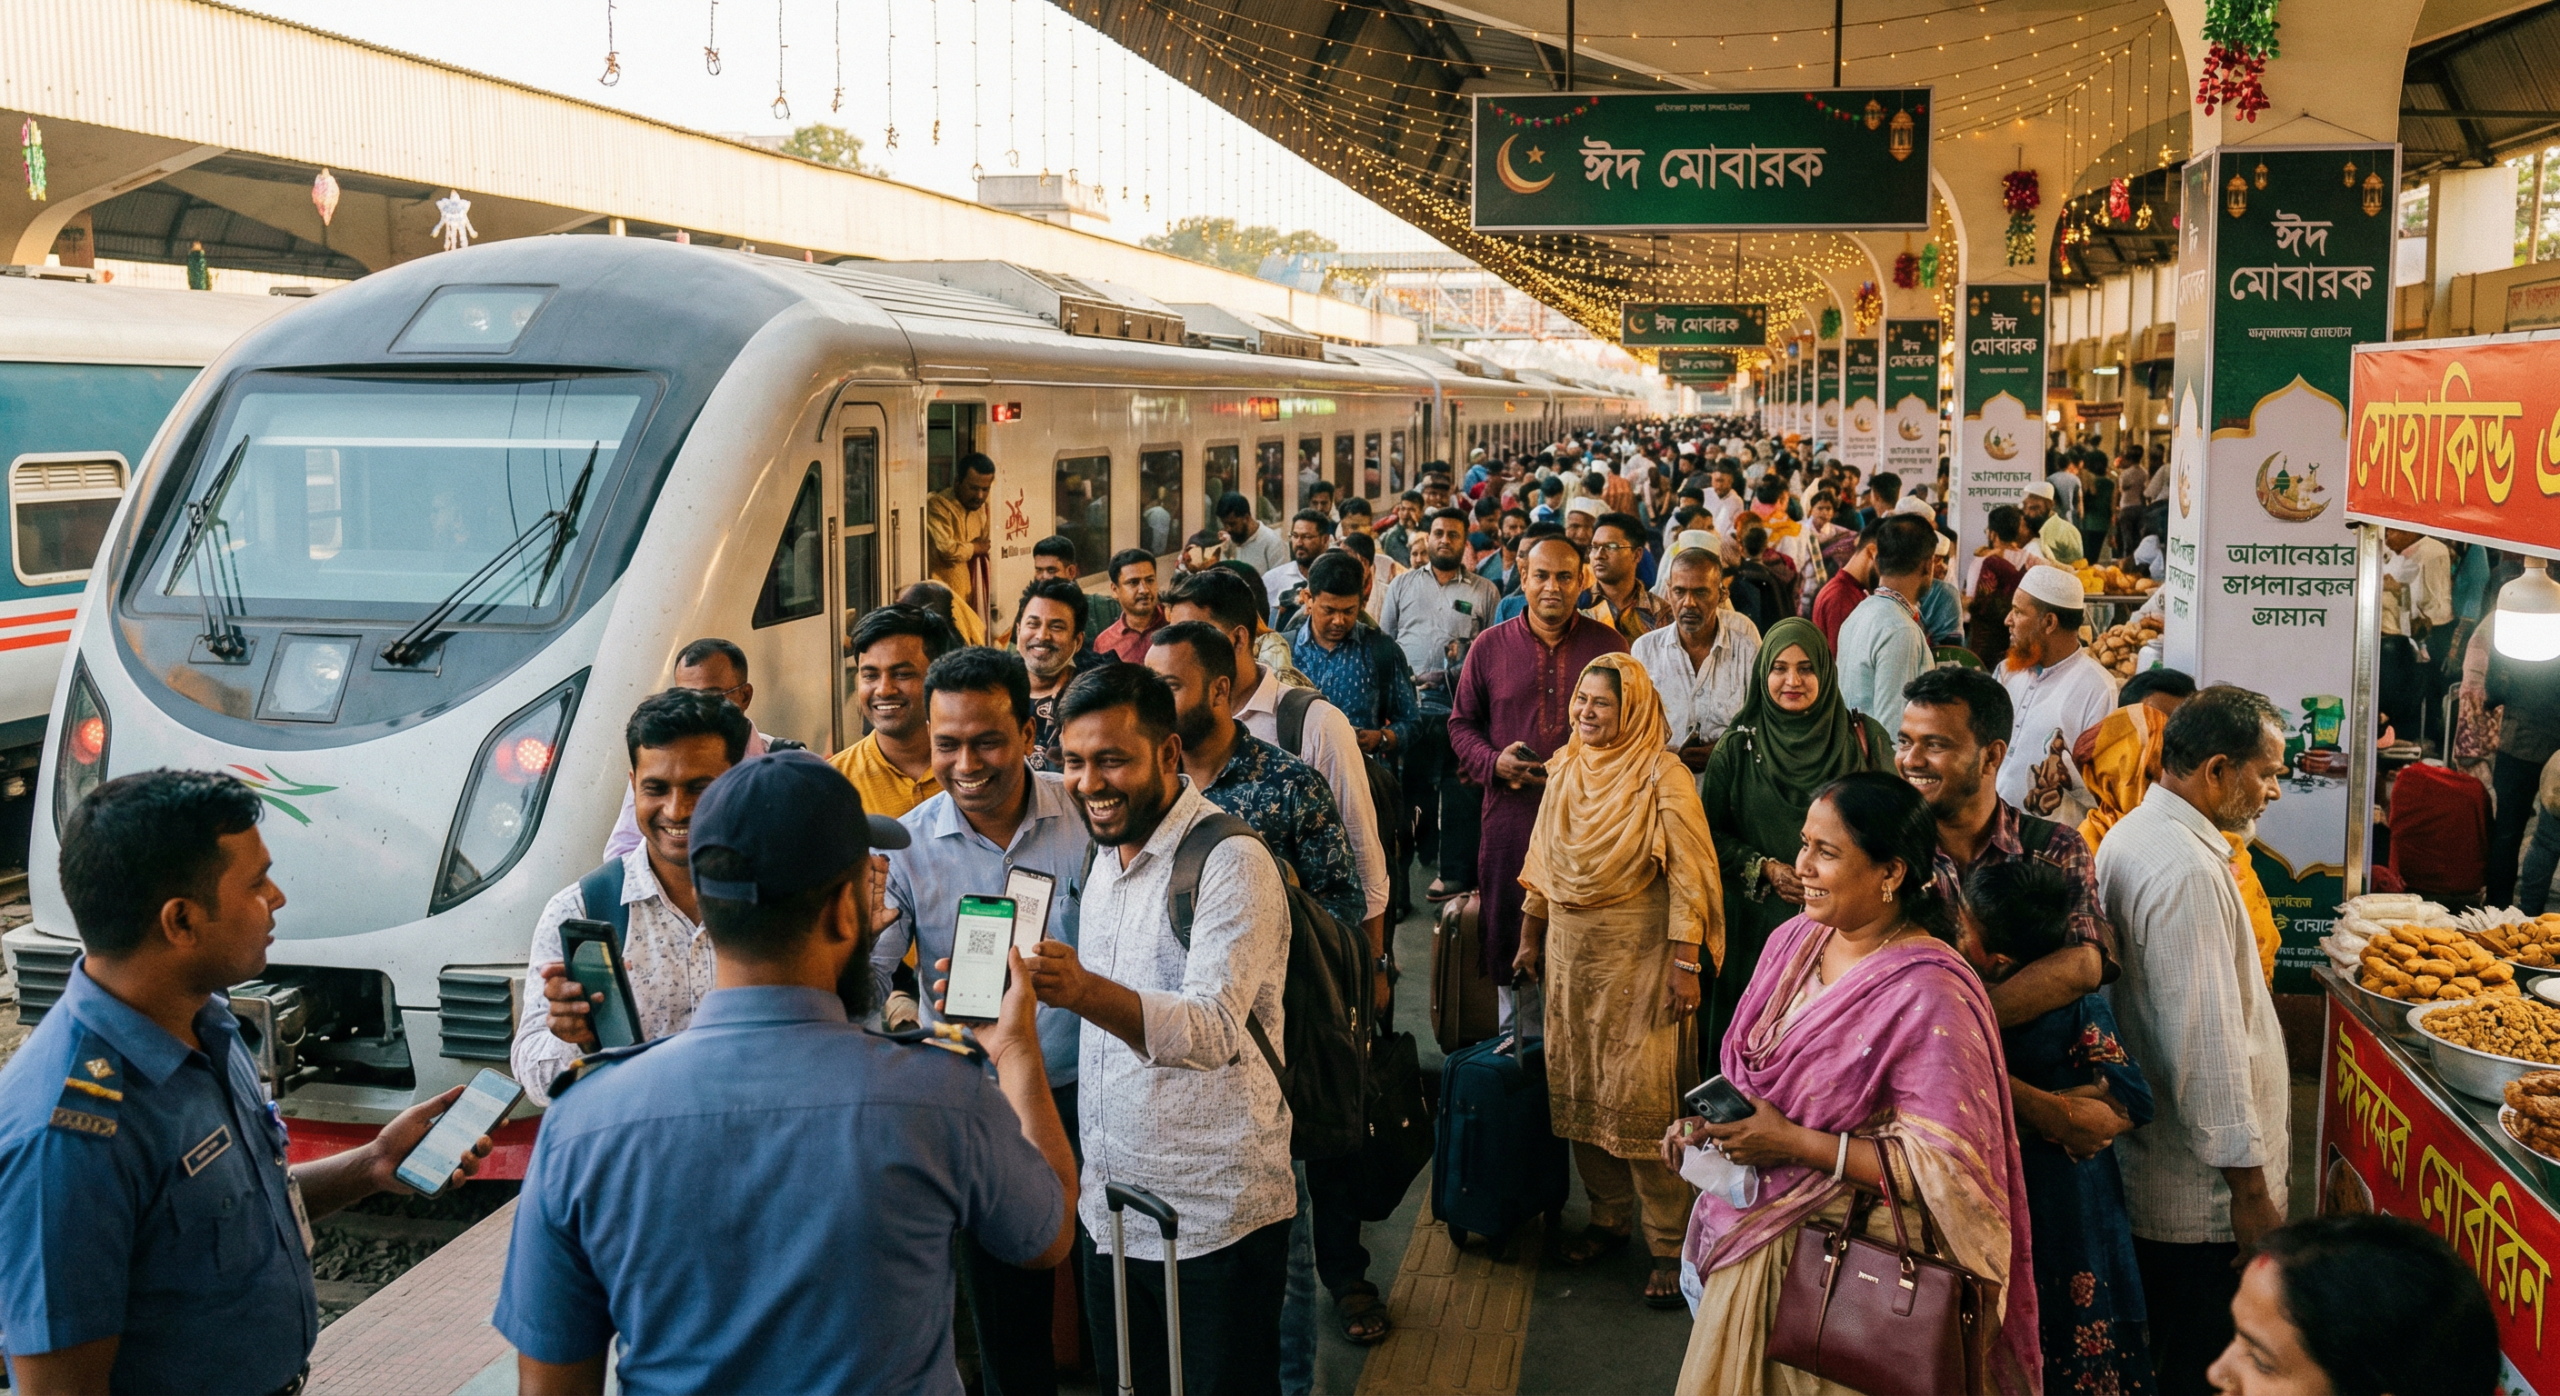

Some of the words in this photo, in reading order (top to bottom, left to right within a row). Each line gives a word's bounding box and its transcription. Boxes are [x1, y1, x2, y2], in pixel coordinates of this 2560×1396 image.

[1579, 135, 1645, 190] ঈদ
[1659, 142, 1826, 190] মোবারক
[2270, 209, 2334, 257] ঈদ
[2229, 262, 2376, 301] মোবারক
[1990, 311, 2018, 334] ঈদ
[1971, 336, 2038, 356] মোবারক
